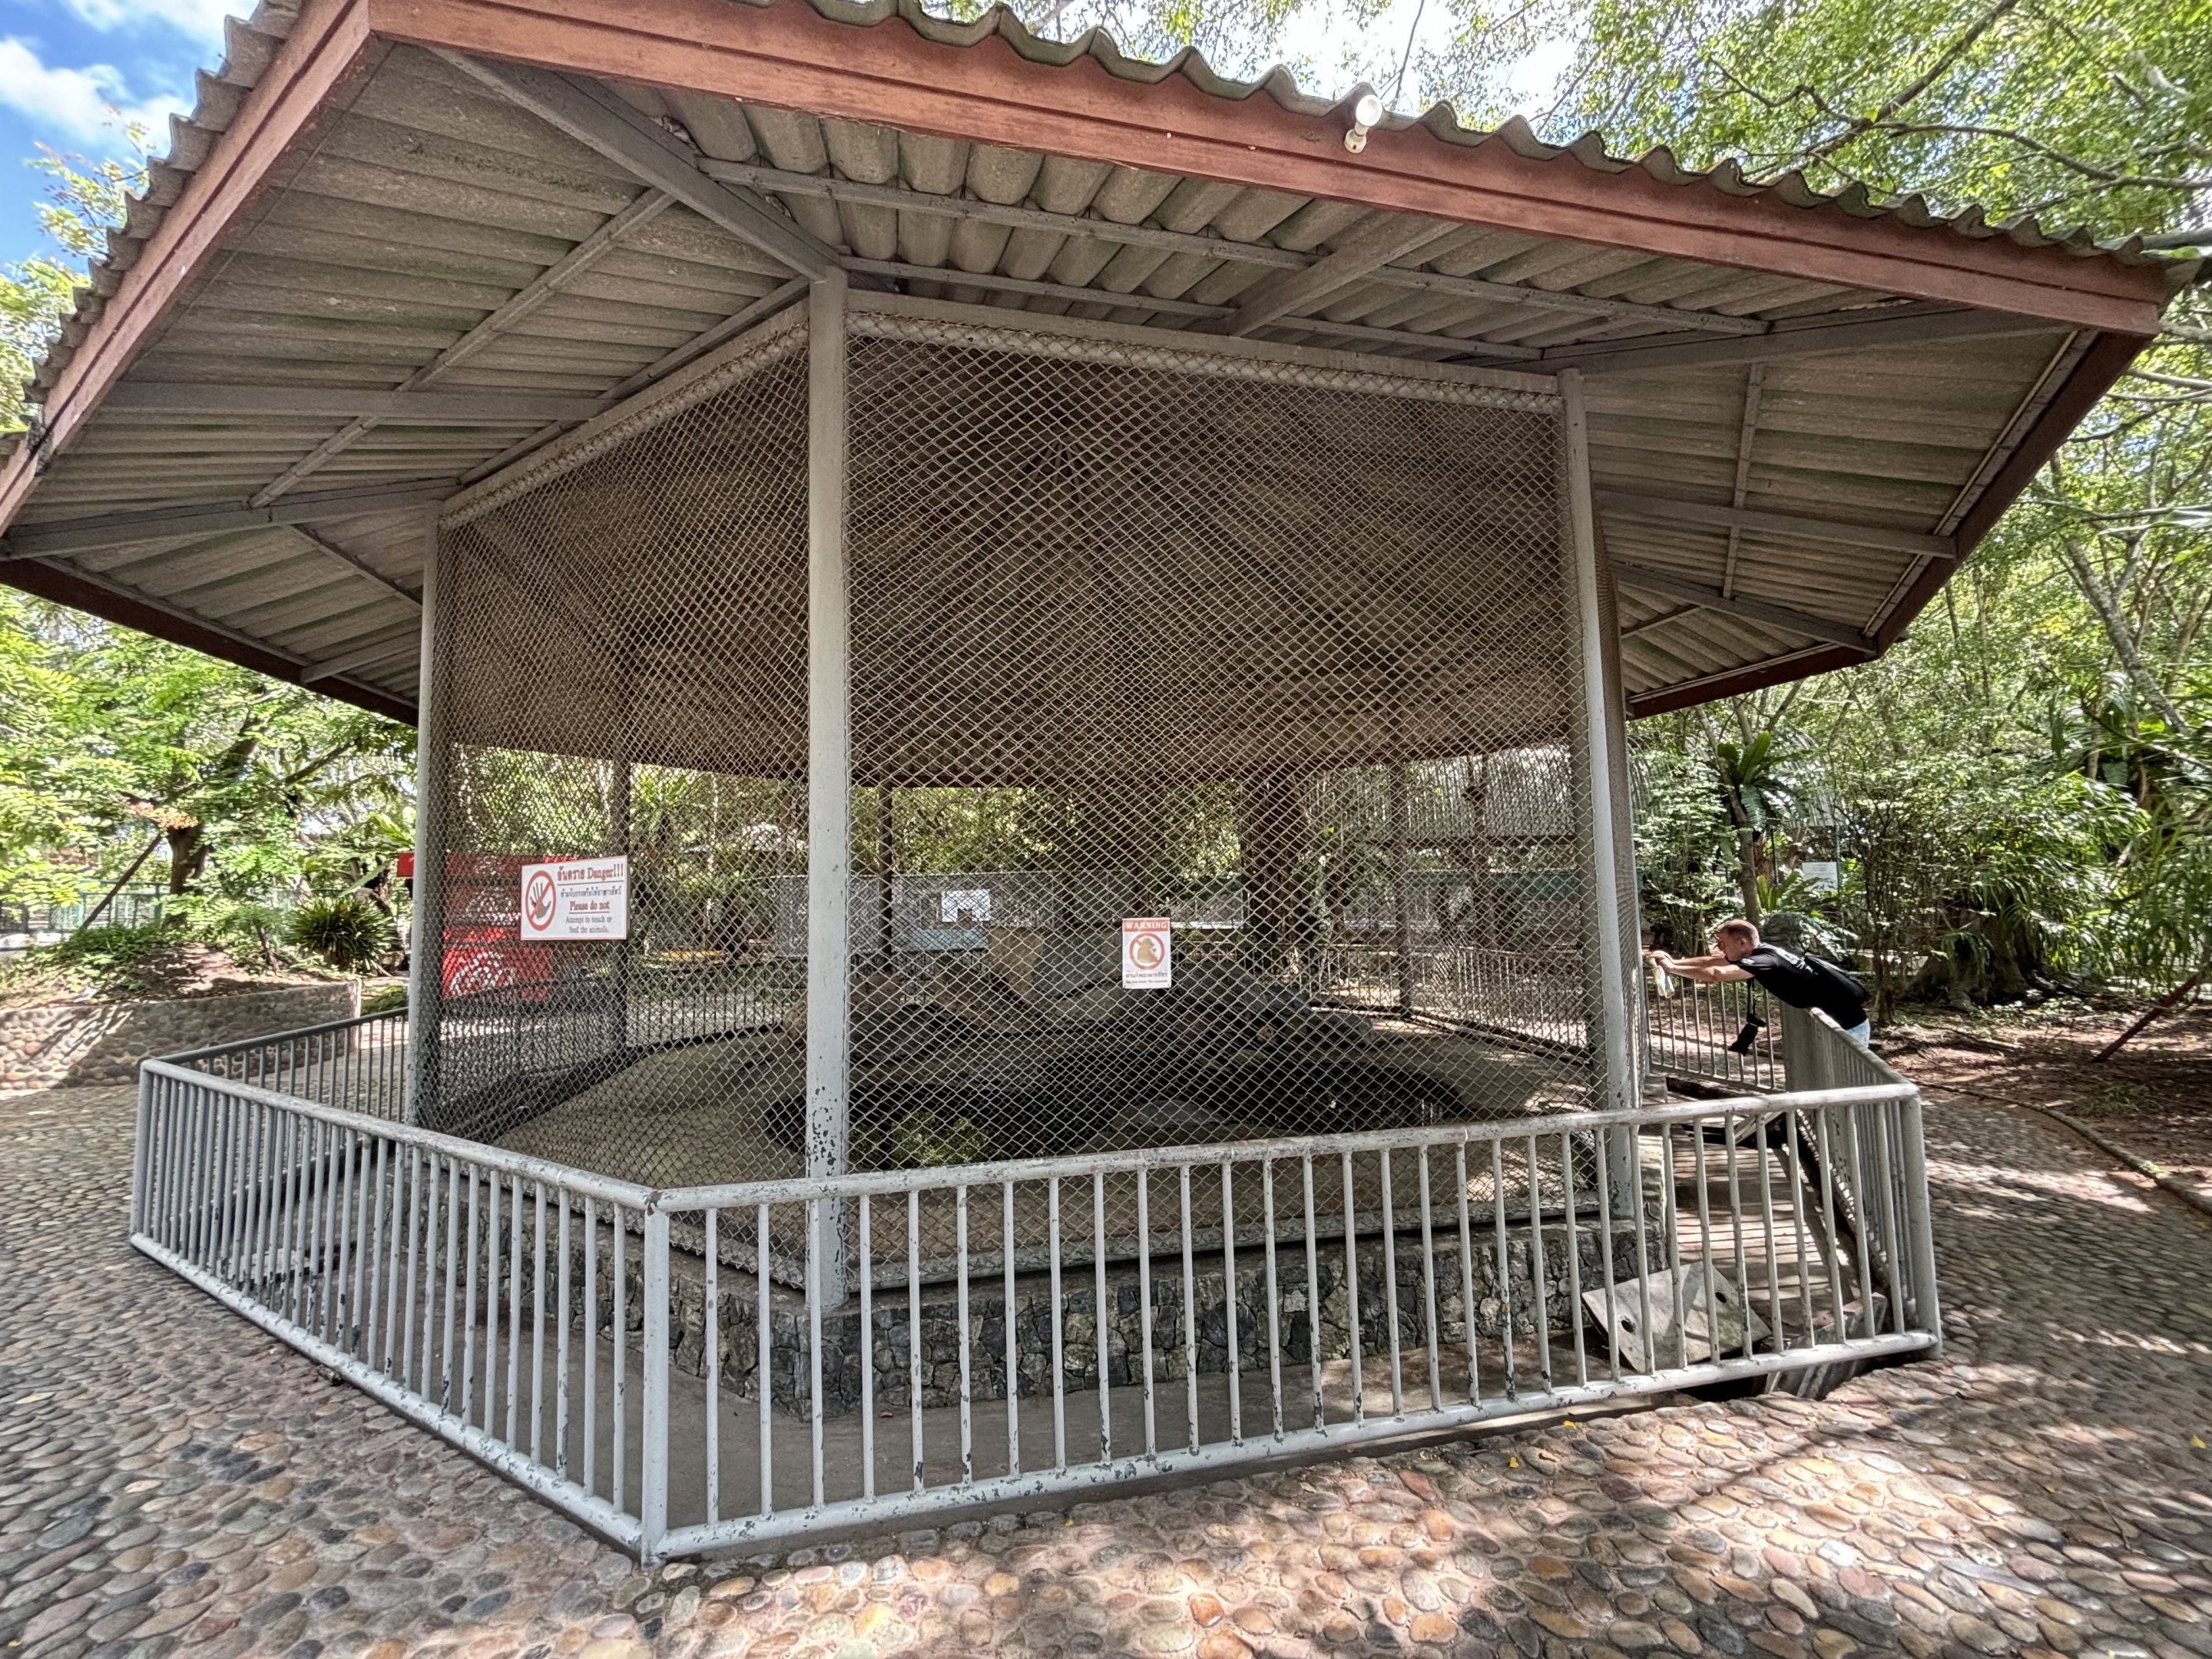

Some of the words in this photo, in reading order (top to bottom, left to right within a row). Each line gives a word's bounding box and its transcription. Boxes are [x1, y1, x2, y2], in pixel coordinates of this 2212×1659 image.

[587, 863, 624, 881] Danger!!!
[570, 901, 588, 911] Please
[590, 900, 597, 910] do
[599, 901, 609, 909] not
